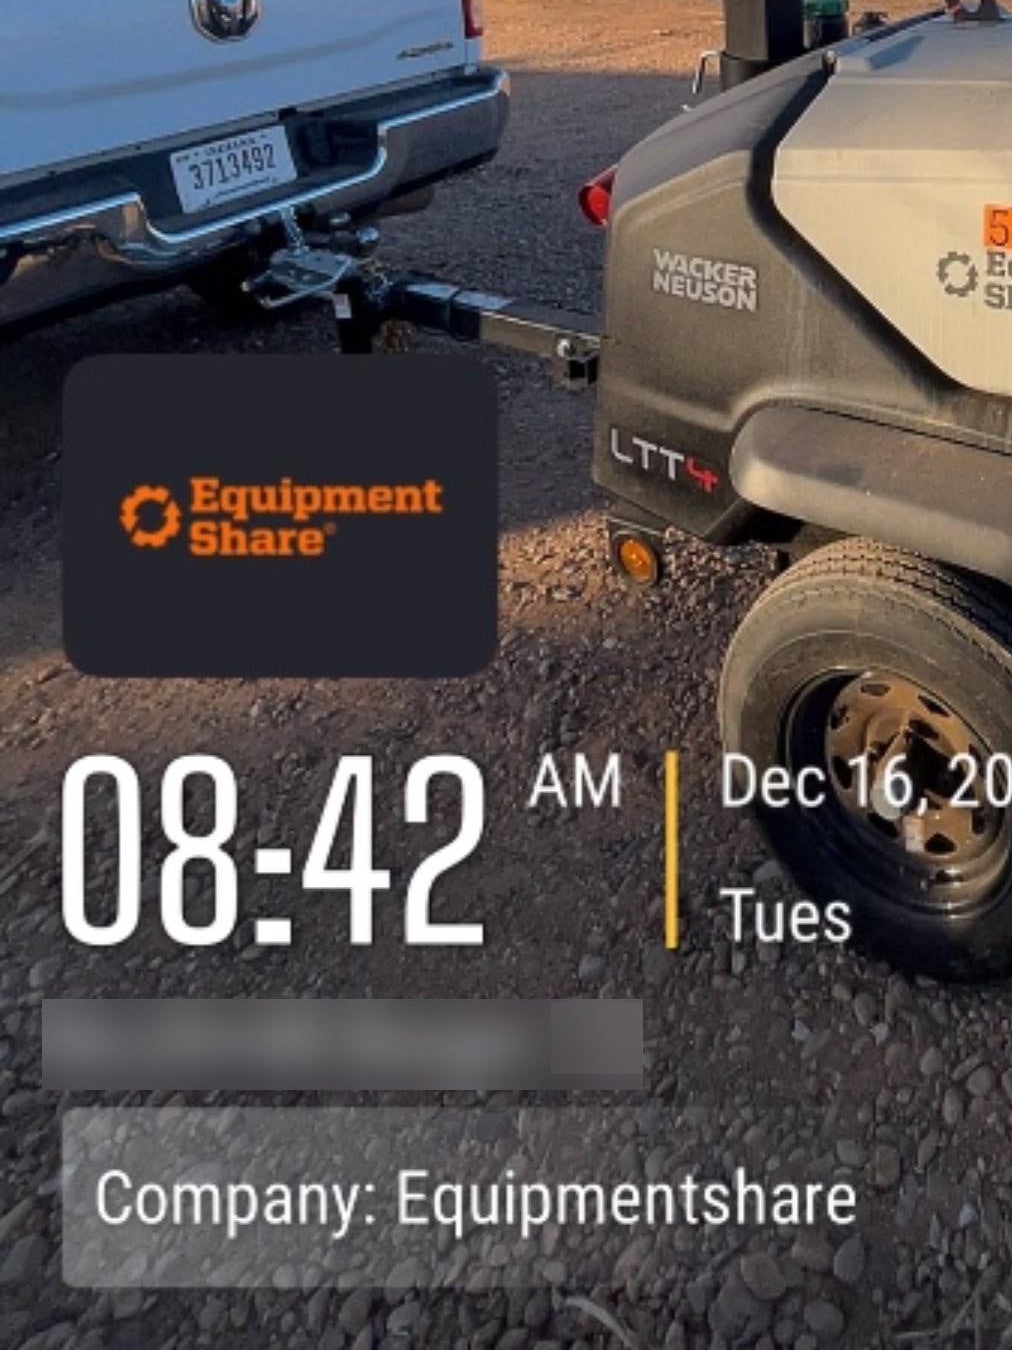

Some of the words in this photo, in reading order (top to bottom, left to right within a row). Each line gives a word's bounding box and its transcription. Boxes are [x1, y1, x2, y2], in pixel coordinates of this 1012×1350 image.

[189, 143, 276, 190] 3713492
[653, 249, 757, 289] WACKER
[653, 270, 757, 312] NEUSON
[610, 428, 718, 493] LTT4
